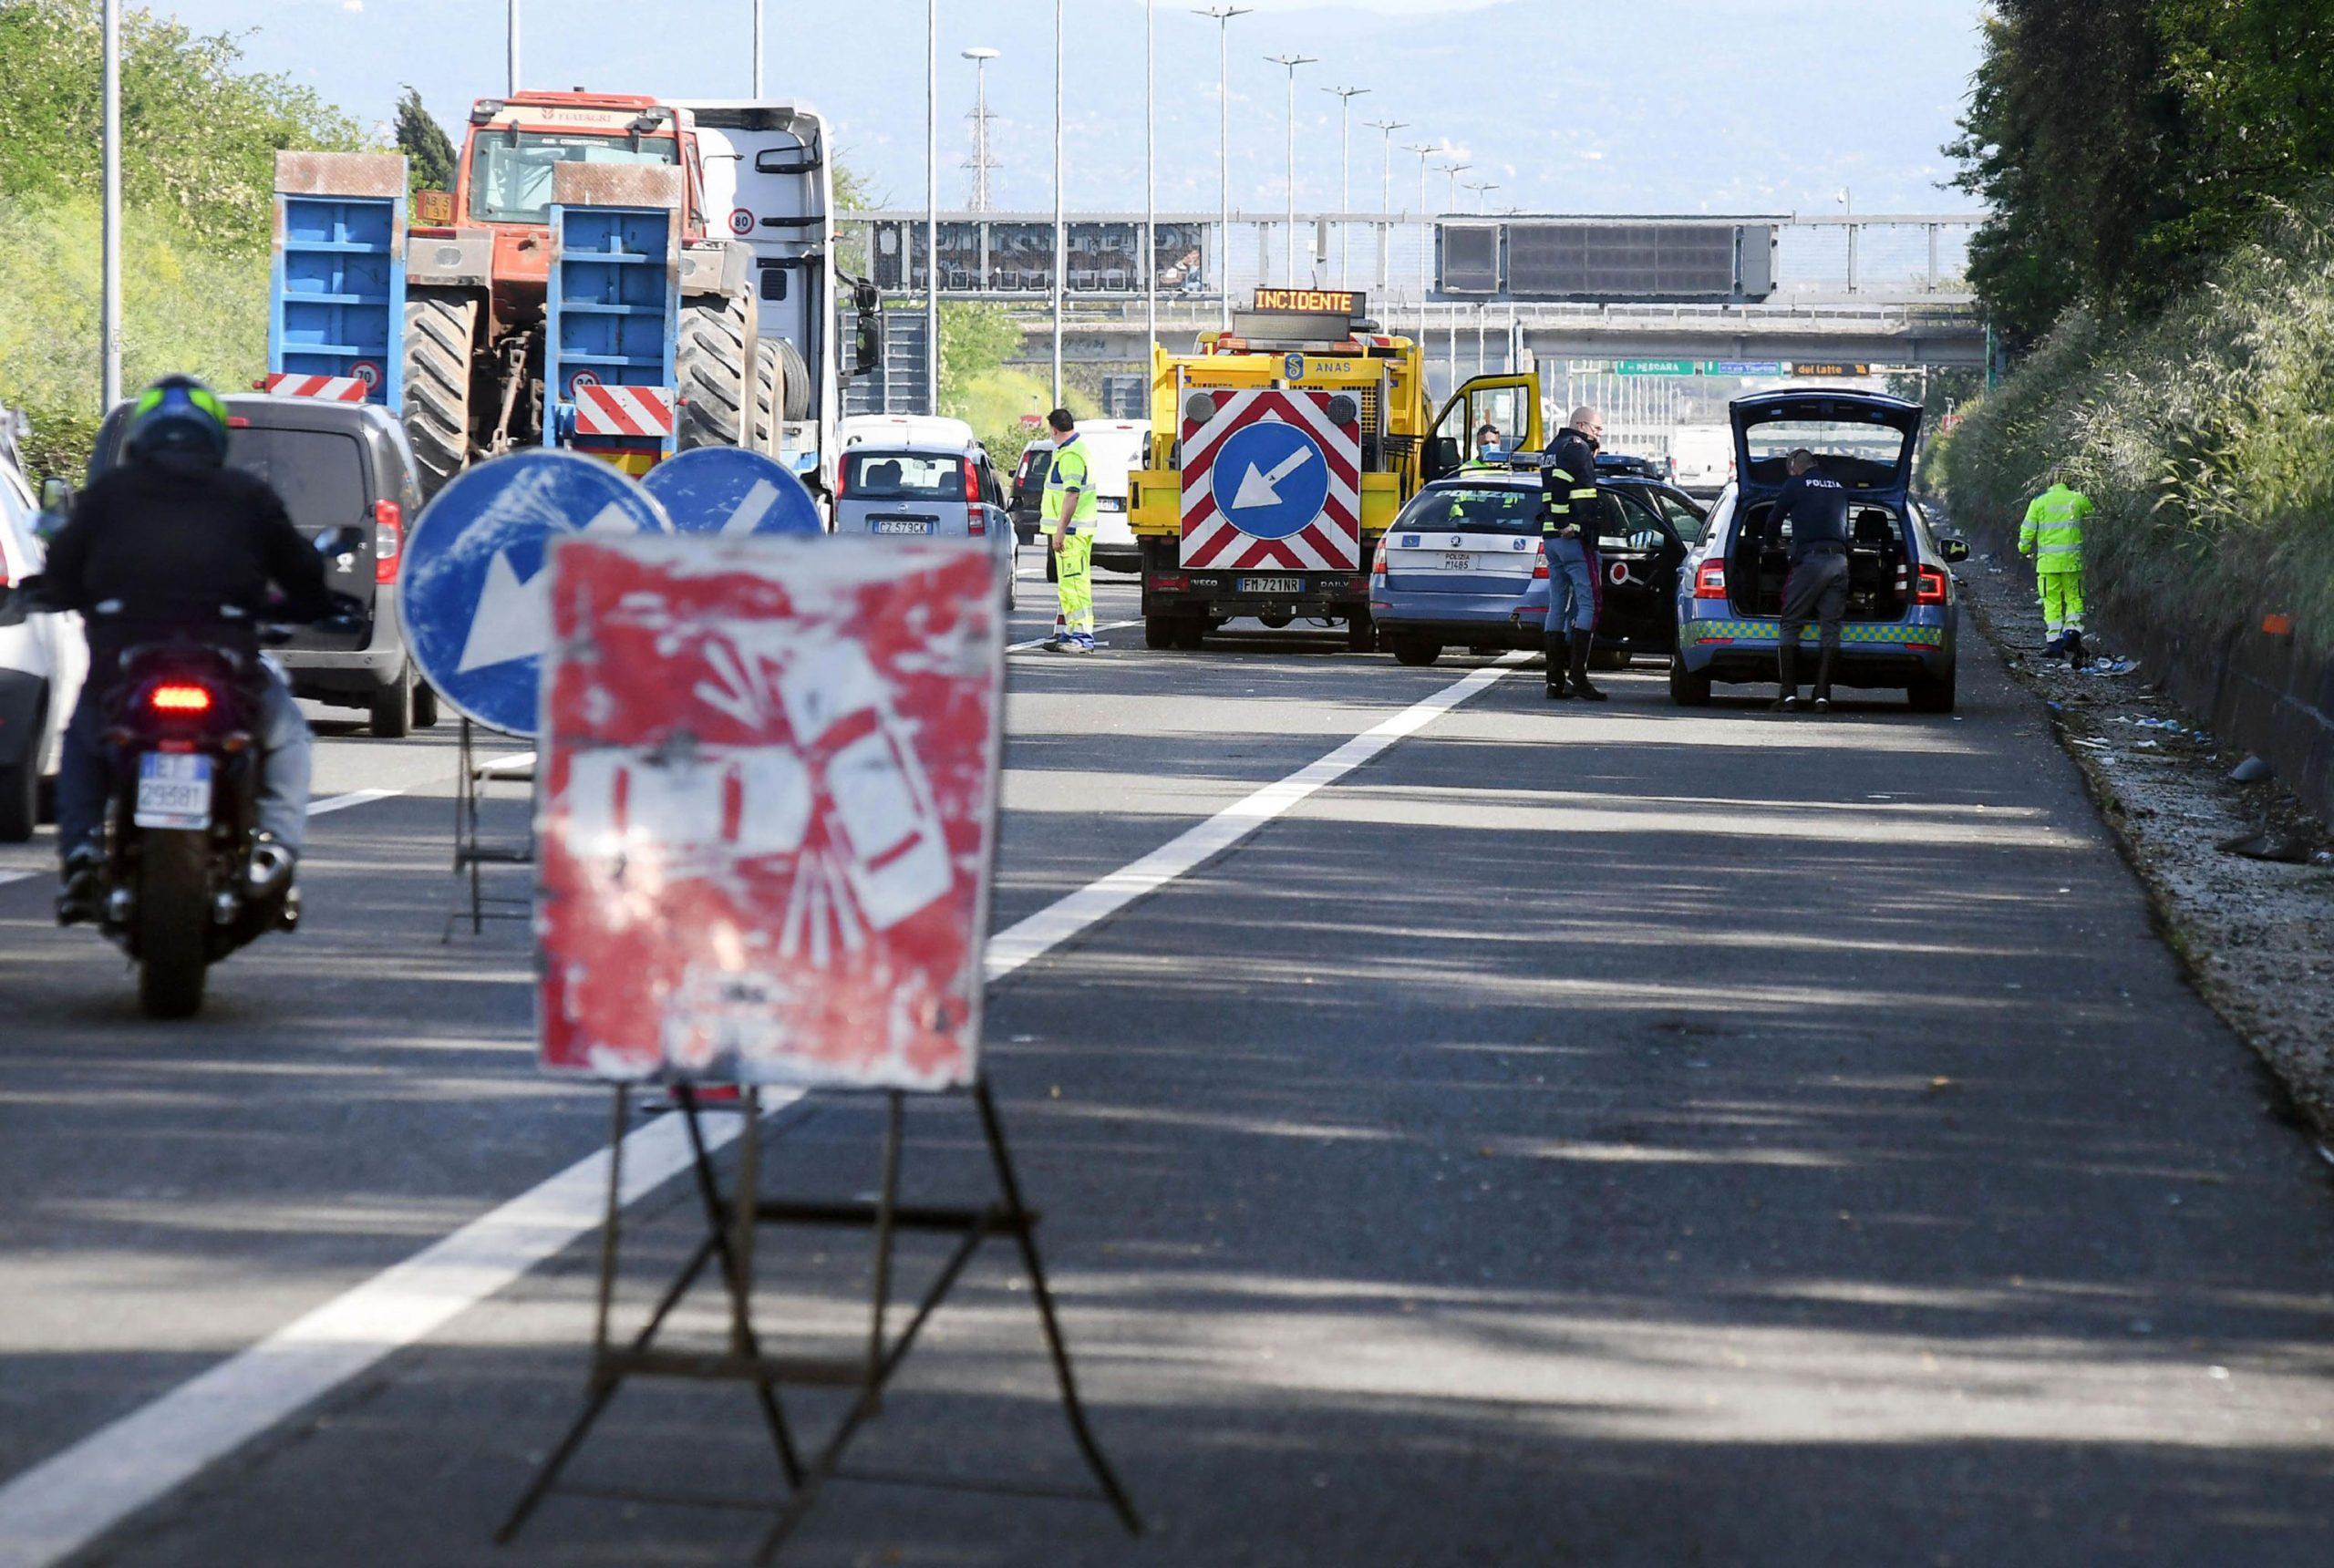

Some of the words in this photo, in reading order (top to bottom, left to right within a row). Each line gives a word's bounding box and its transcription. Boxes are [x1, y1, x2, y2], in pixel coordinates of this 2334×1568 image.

[734, 215, 749, 227] 80
[1255, 291, 1353, 311] INCIDENTE
[1315, 361, 1351, 373] ANAS
[1636, 362, 1679, 372] PESCARA
[357, 369, 372, 384] 70
[1805, 479, 1843, 489] POLIZIA
[1445, 552, 1471, 561] POLIZIA
[1191, 579, 1219, 587] IVECO
